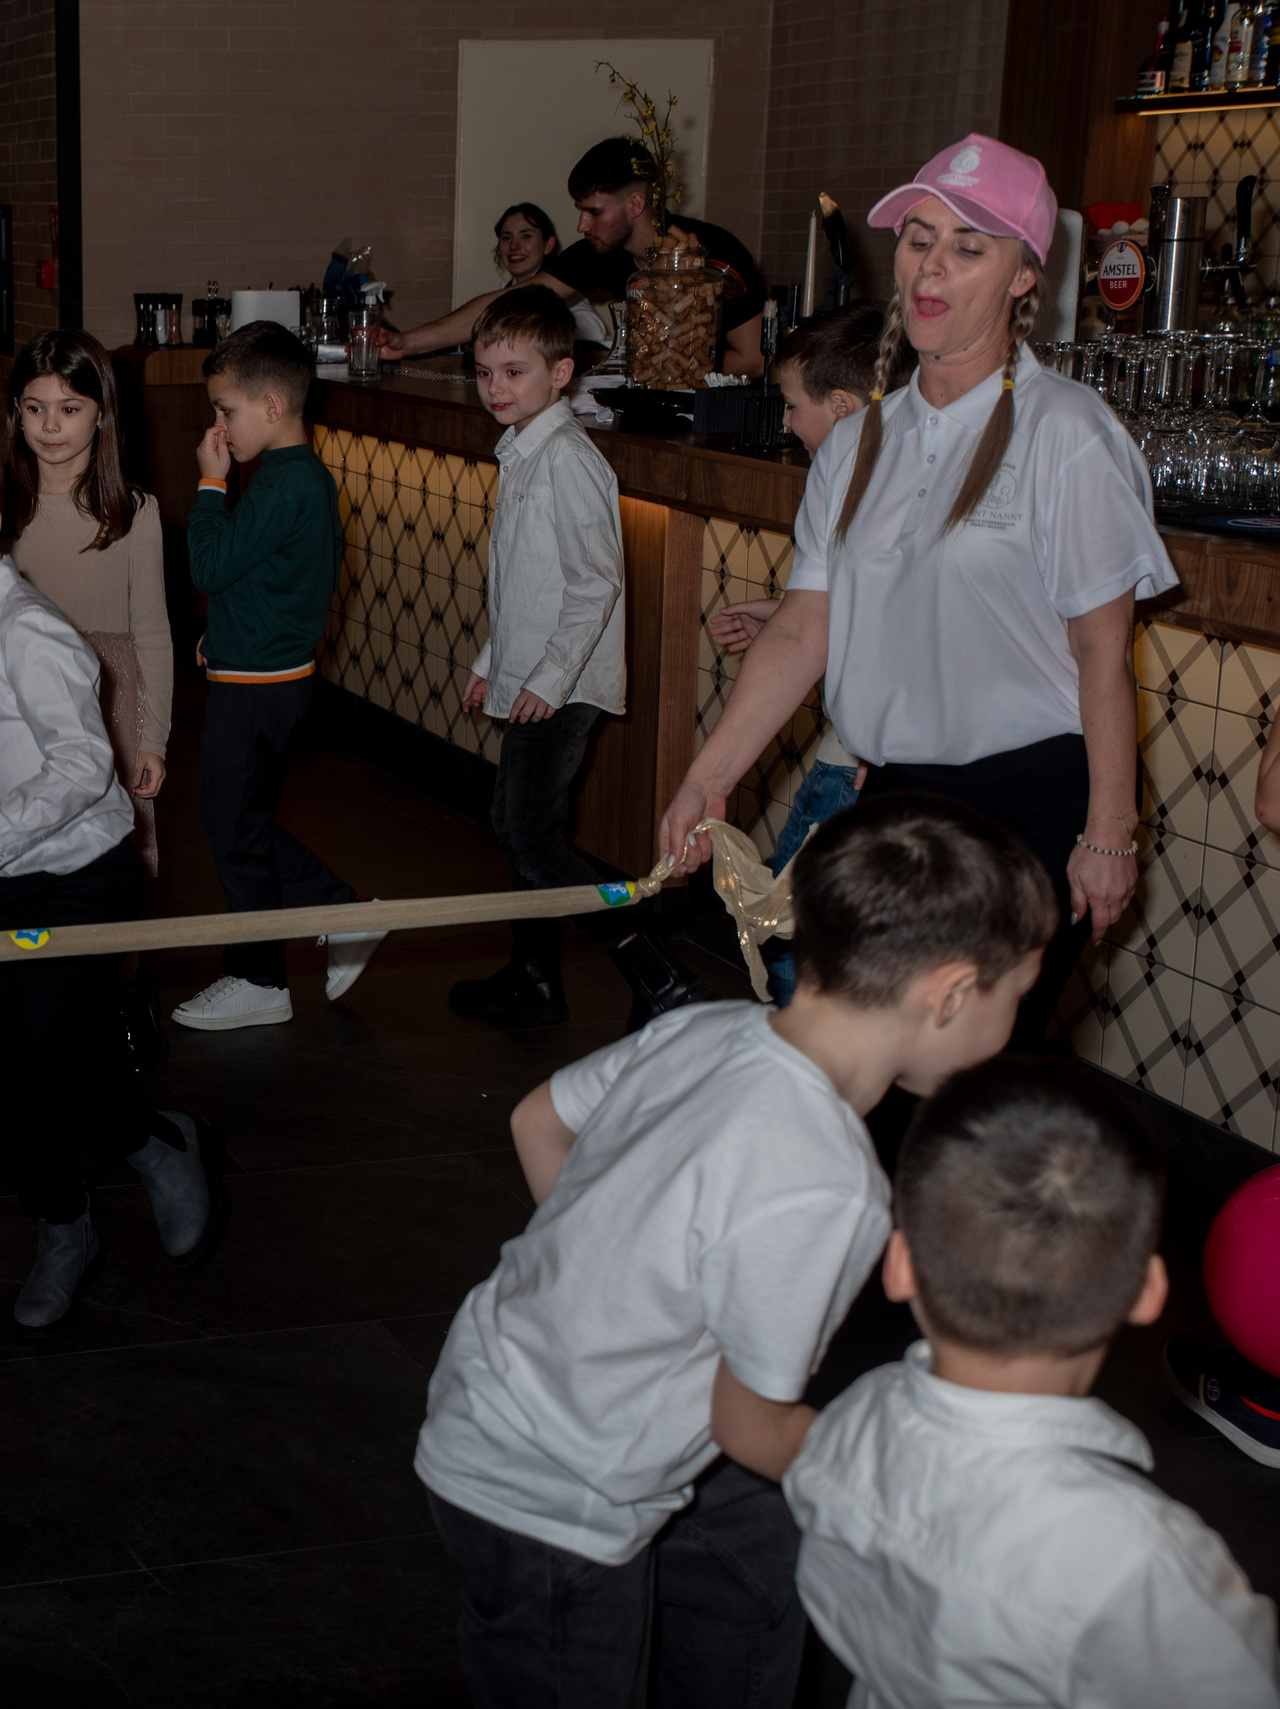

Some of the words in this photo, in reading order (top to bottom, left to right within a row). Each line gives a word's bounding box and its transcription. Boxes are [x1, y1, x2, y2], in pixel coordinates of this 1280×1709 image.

[1103, 263, 1137, 276] AMSTEL
[1109, 280, 1128, 290] BEER
[990, 511, 1023, 521] NANNY
